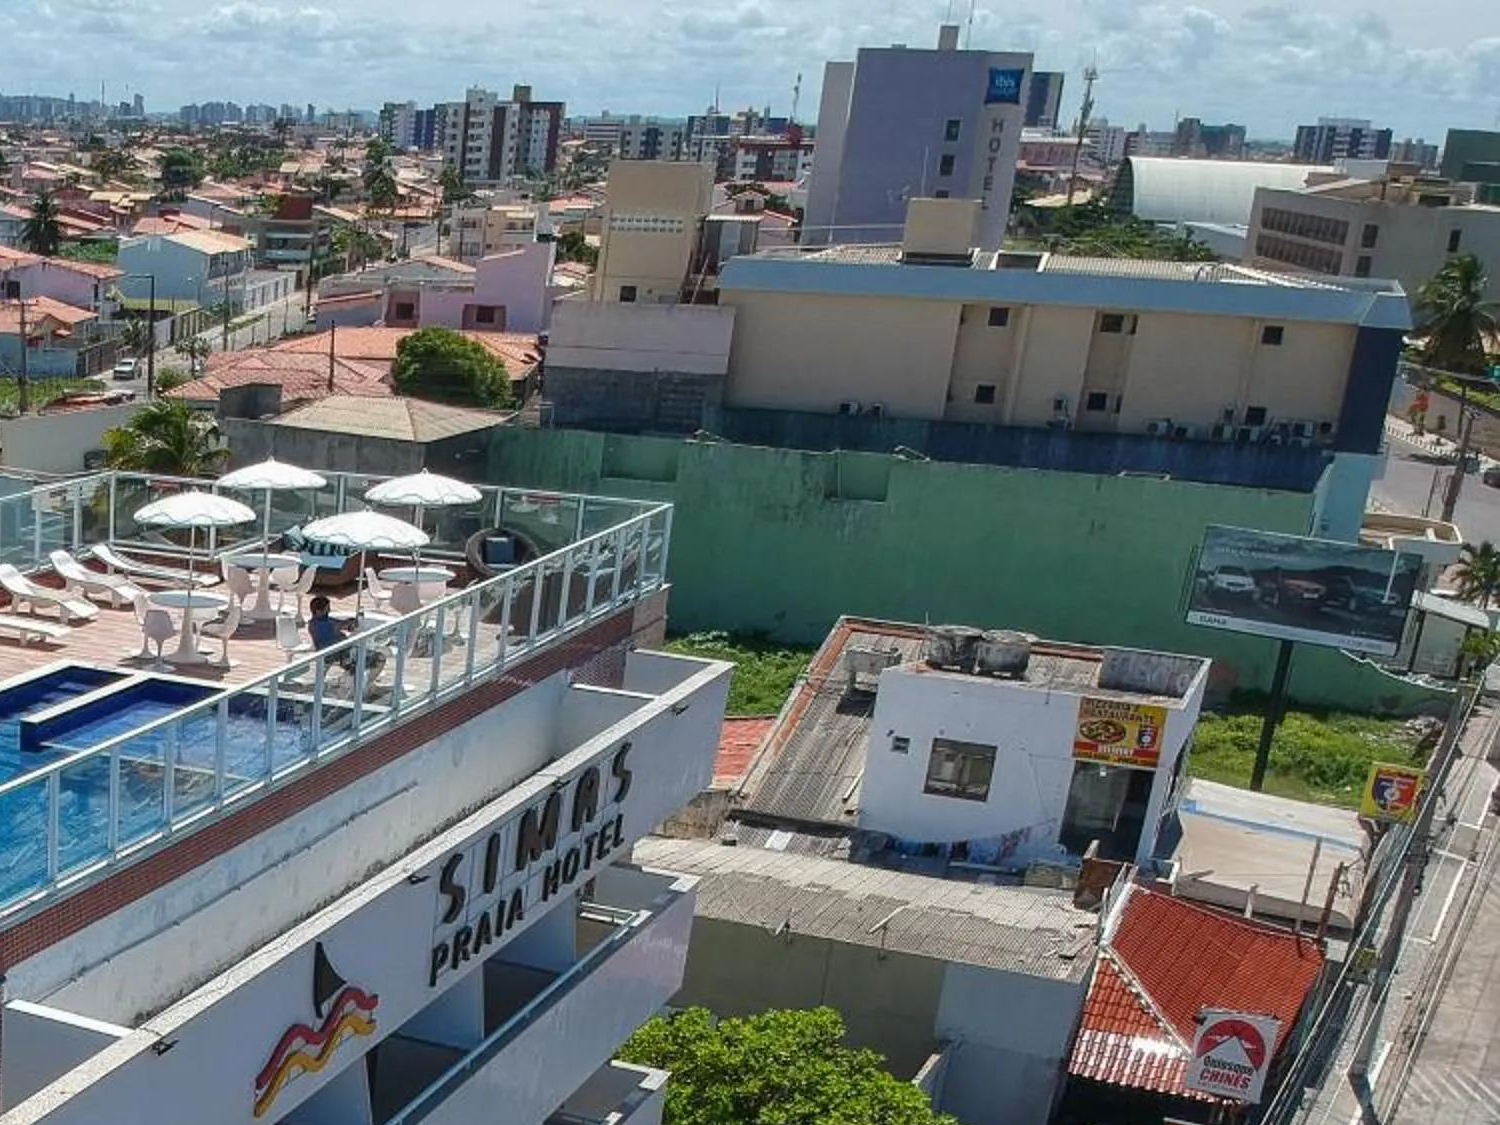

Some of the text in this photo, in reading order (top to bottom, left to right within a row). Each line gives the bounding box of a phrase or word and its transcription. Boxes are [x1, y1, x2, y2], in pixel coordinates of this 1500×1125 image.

[981, 119, 1004, 211] HOTEL
[429, 813, 625, 987] PRAIA HOTEL
[440, 742, 632, 924] SIMAS
